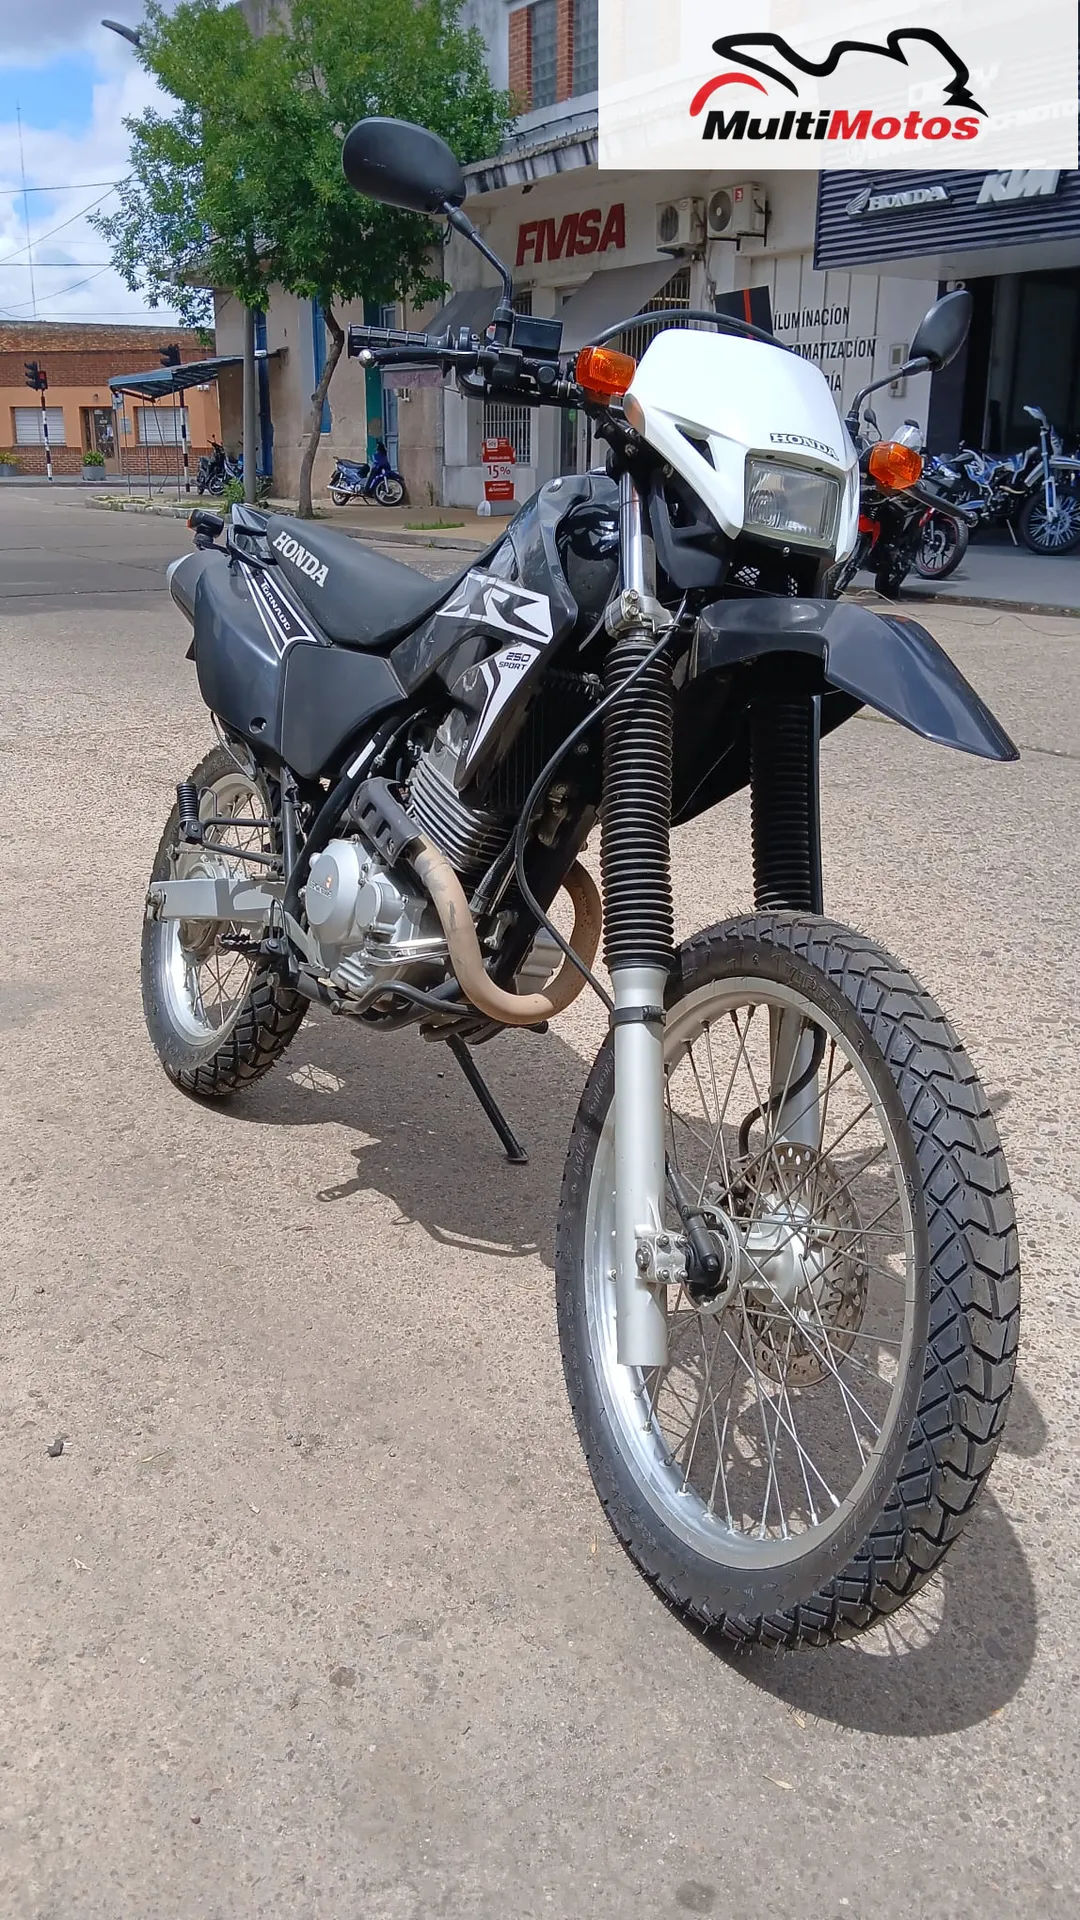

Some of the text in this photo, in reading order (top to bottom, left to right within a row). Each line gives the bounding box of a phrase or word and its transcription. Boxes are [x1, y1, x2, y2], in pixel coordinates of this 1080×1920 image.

[868, 185, 949, 211] HONDA
[976, 166, 1061, 204] KTM
[769, 432, 841, 461] HONDA
[487, 464, 511, 479] 15%
[272, 530, 329, 588] HONDA
[498, 661, 528, 671] SPORT
[505, 651, 532, 663] 250
